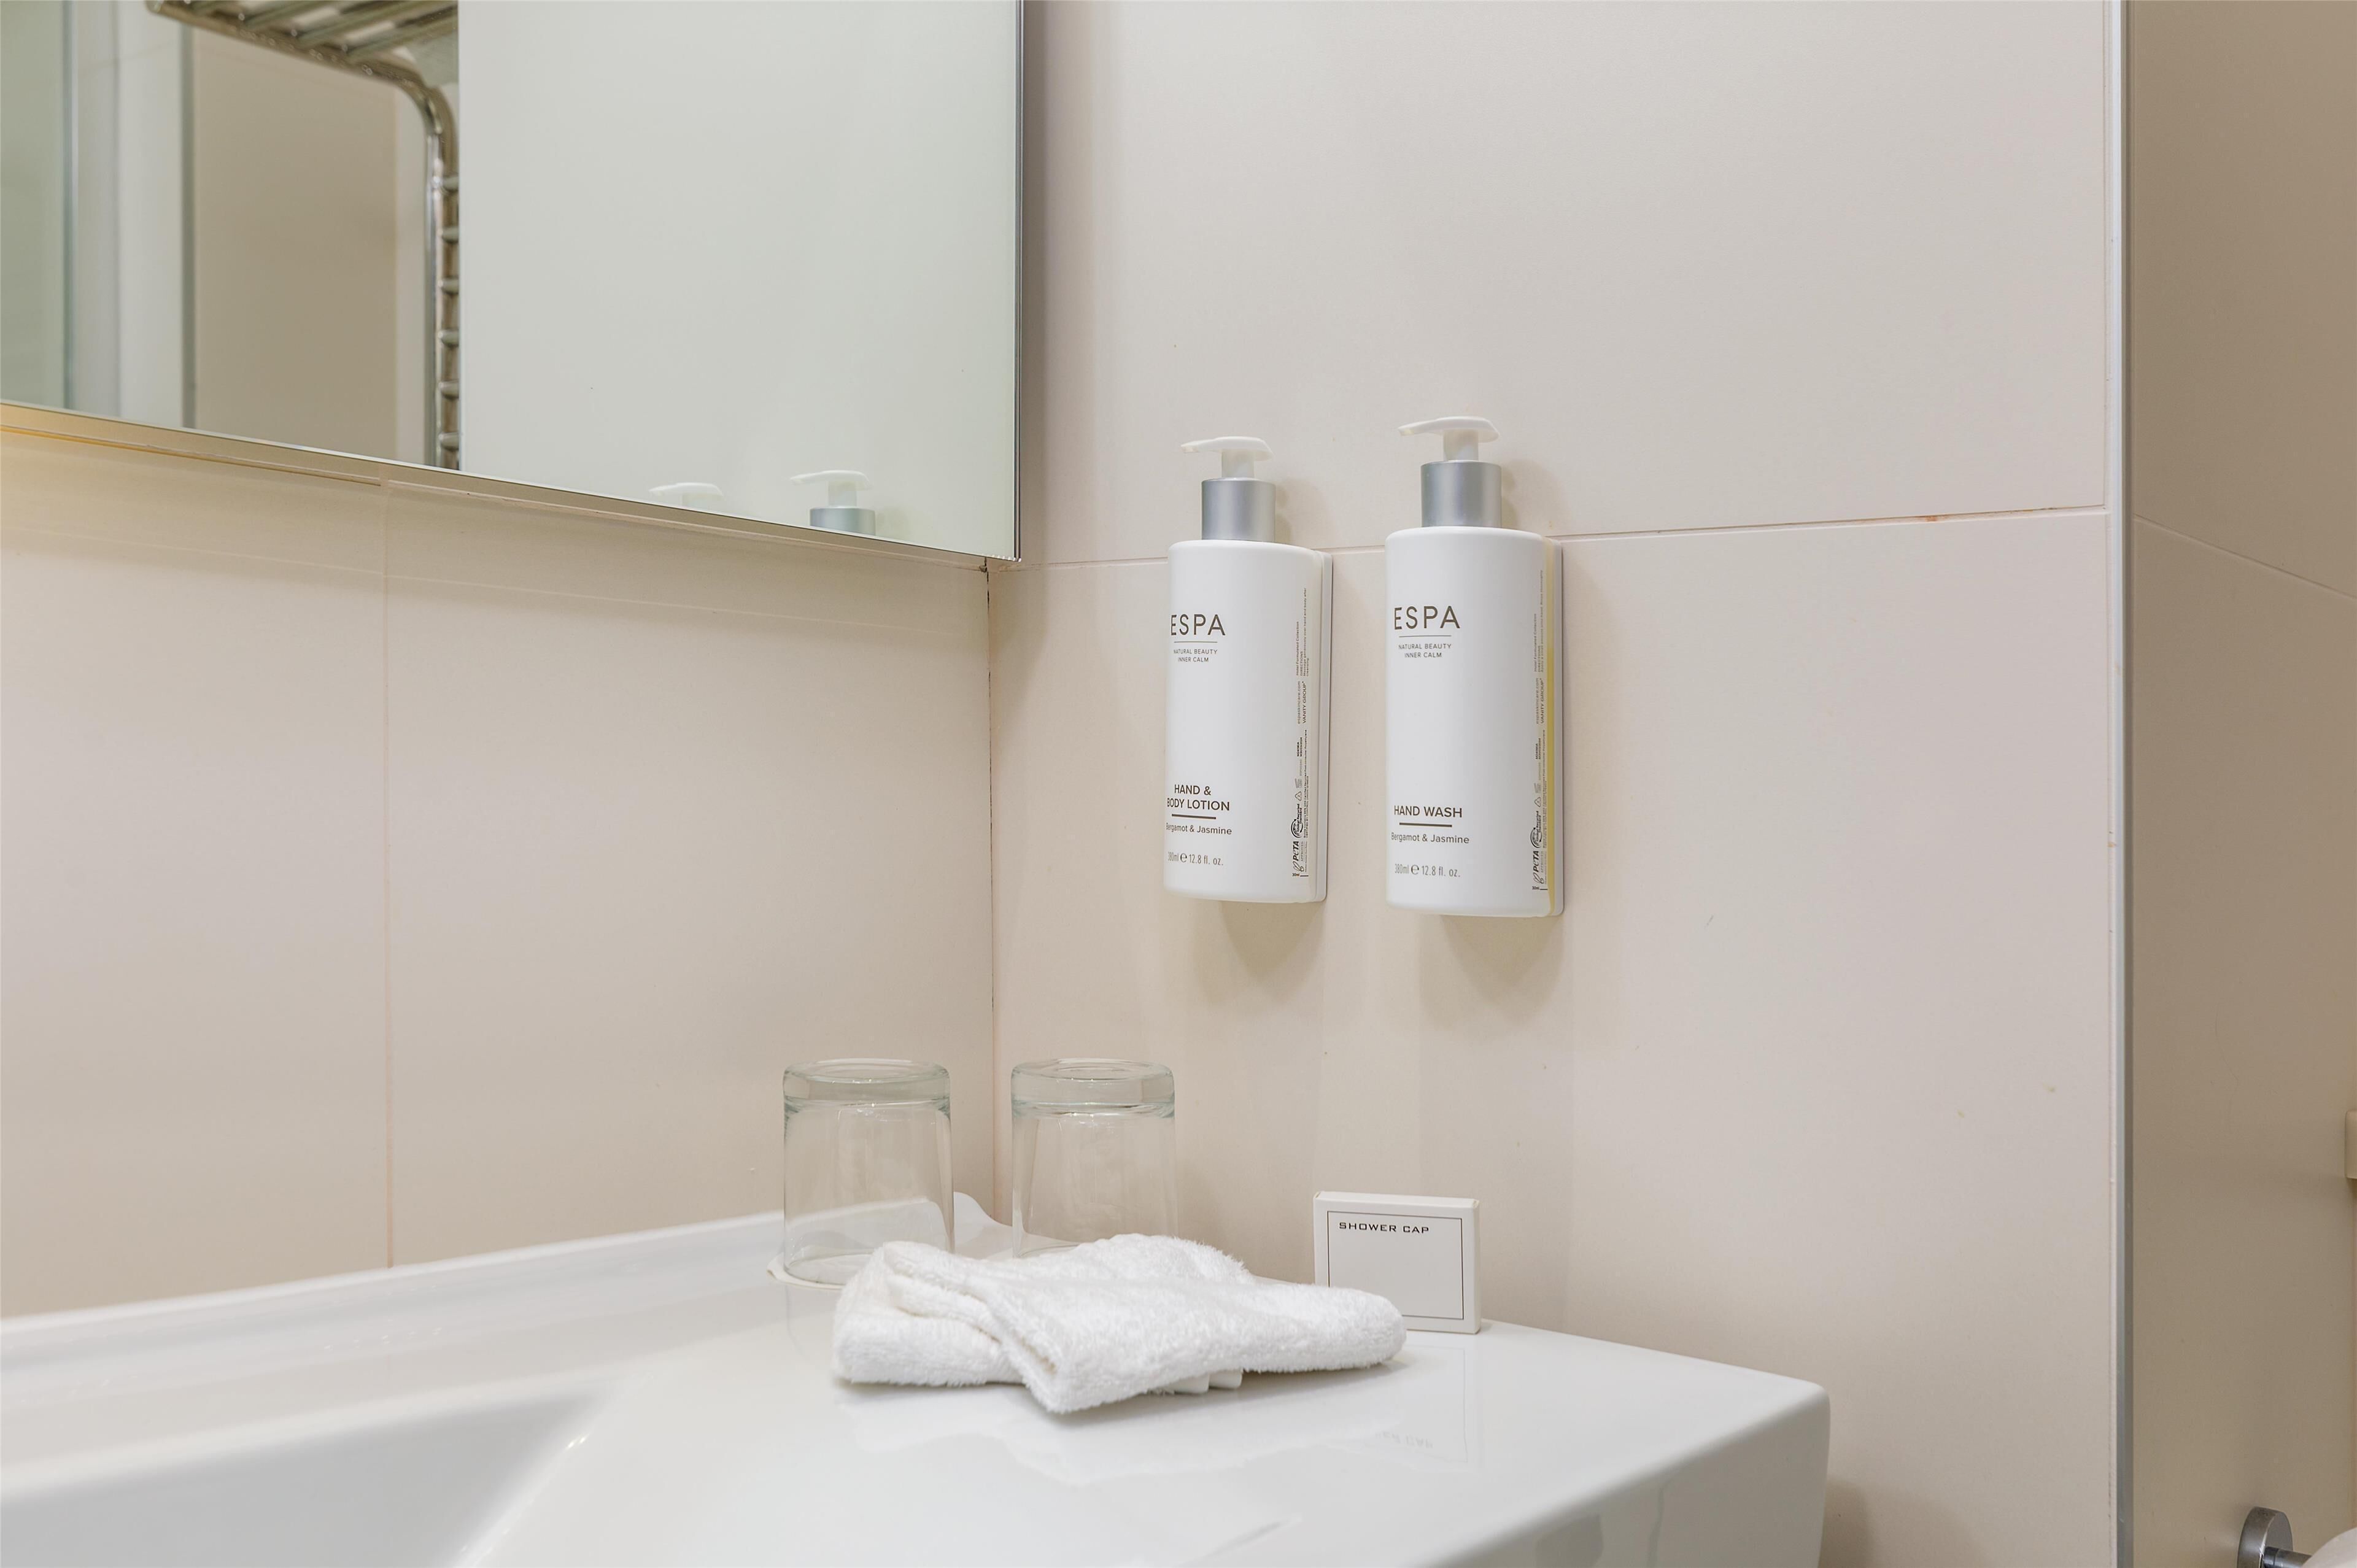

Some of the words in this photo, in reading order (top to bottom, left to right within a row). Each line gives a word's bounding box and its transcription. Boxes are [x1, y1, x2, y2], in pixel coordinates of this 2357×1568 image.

[1394, 606, 1460, 630] ESPA
[1171, 614, 1226, 636] ESPA
[1174, 784, 1200, 795] HAND
[1204, 786, 1211, 795] &
[1167, 798, 1185, 808] BODY
[1187, 800, 1230, 811] LOTION
[1394, 805, 1420, 816] HAND
[1423, 806, 1462, 818] WASH
[1197, 825, 1232, 835] Jasmine
[1391, 832, 1420, 843] Bergamot
[1422, 833, 1428, 842] &
[1430, 834, 1469, 844] Jasmine
[1189, 854, 1201, 864] 12.8
[1422, 865, 1436, 876] 12.8
[1339, 1222, 1396, 1232] SHOWER
